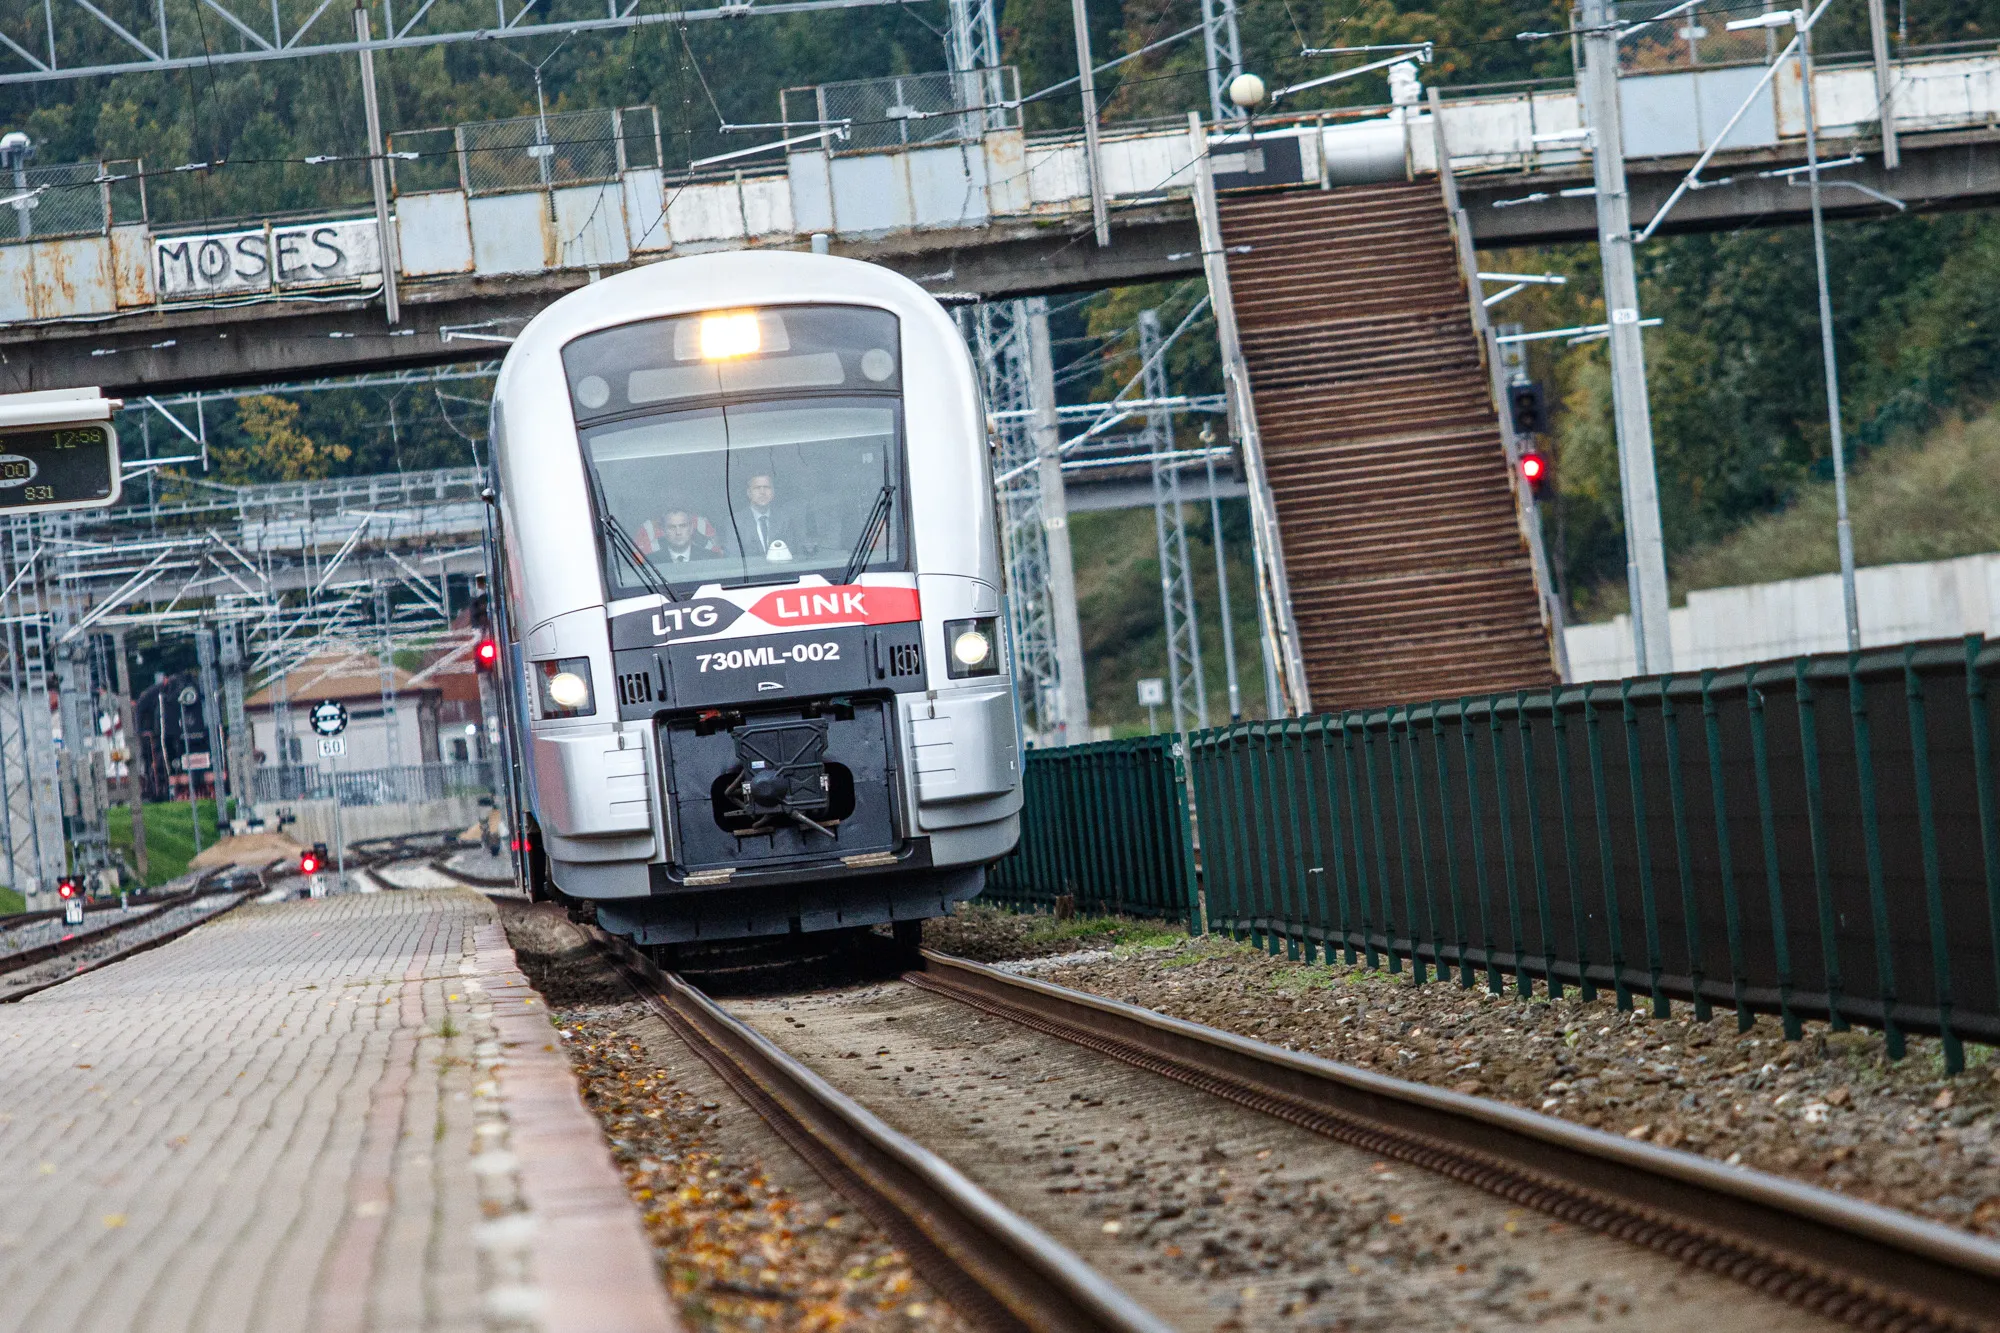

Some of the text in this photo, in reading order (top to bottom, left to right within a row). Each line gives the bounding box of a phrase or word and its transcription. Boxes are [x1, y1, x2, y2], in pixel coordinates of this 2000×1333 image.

[157, 228, 345, 291] MOSES
[25, 485, 54, 500] 831
[652, 592, 869, 636] LTG LINK
[696, 642, 840, 673] 730ML-002
[323, 740, 341, 754] 60
